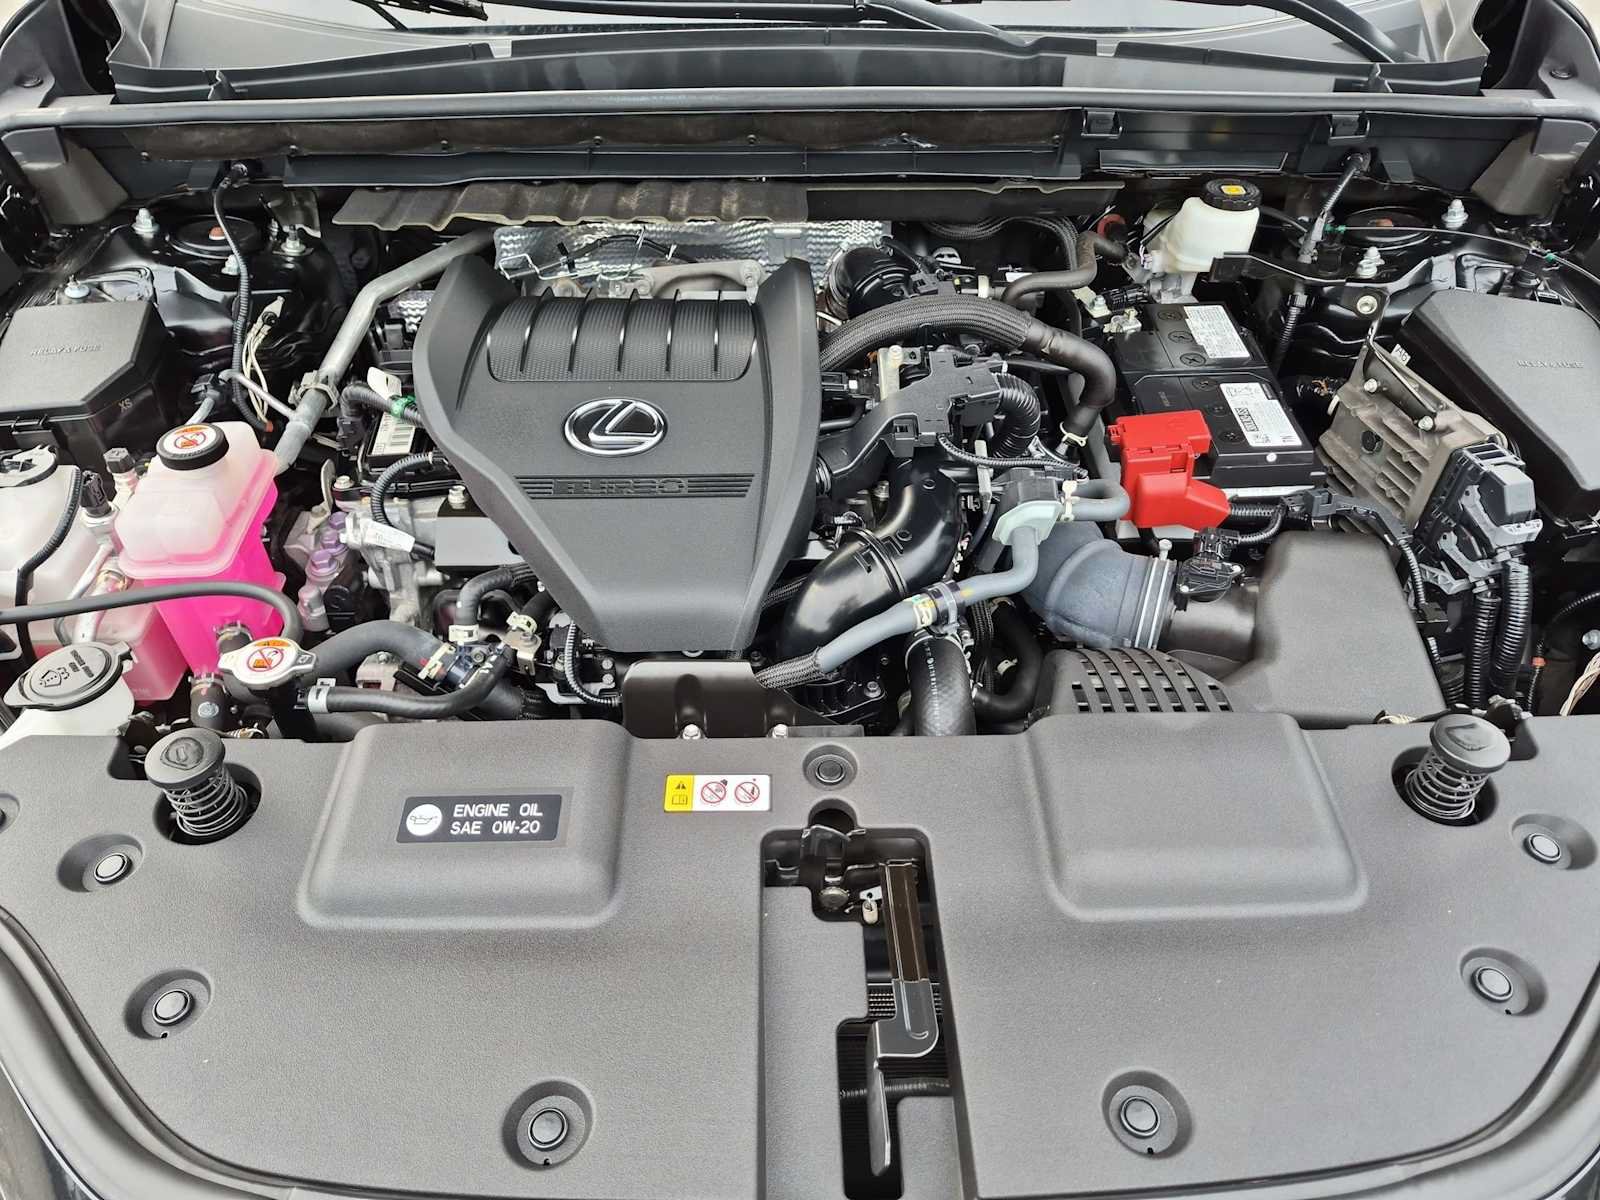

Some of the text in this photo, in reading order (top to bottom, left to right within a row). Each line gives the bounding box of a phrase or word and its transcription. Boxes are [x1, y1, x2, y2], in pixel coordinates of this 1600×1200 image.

[552, 478, 685, 496] TURBO
[453, 802, 543, 817] ENGINE OIL
[449, 820, 540, 835] SAE 0W-20
